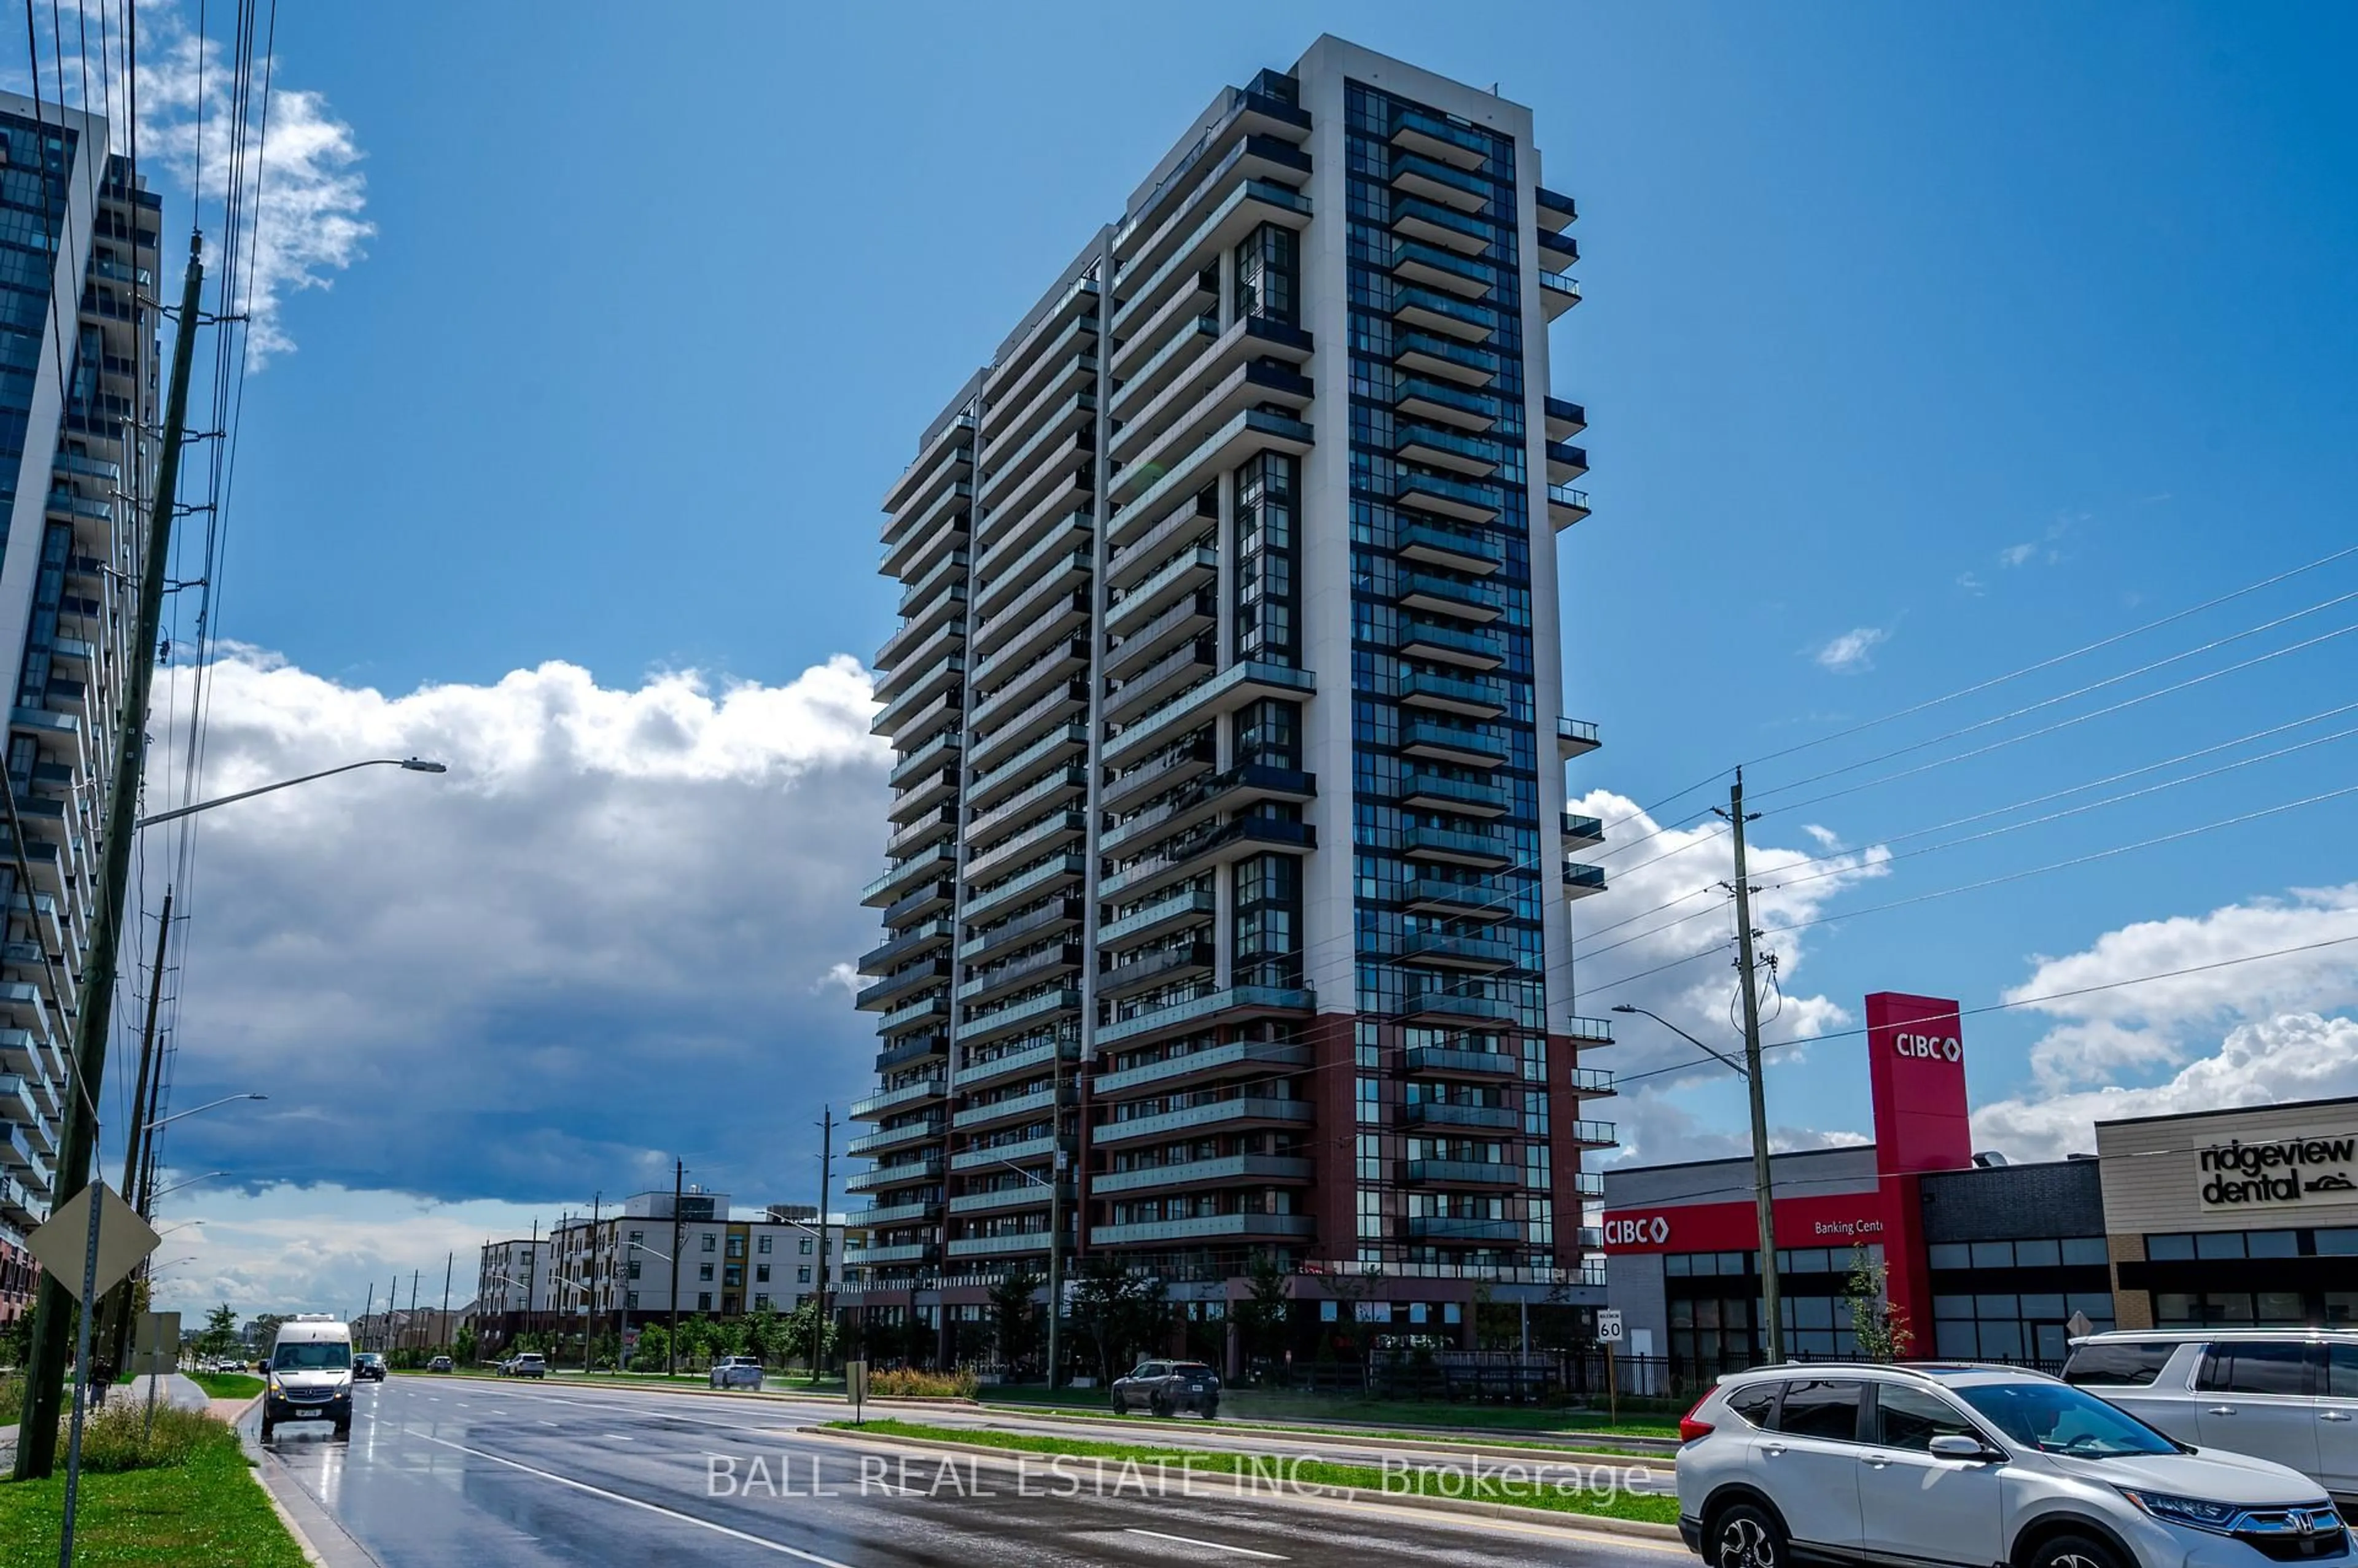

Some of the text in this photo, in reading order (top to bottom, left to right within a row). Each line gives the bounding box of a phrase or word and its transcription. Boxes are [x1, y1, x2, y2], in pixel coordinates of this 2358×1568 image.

[1897, 1033, 1941, 1059] CIBC
[2201, 1138, 2354, 1178] ridgeview
[2203, 1168, 2302, 1204] dental
[1605, 1219, 1648, 1244] CIBC
[1815, 1221, 1854, 1235] Banking
[1601, 1323, 1620, 1337] 60
